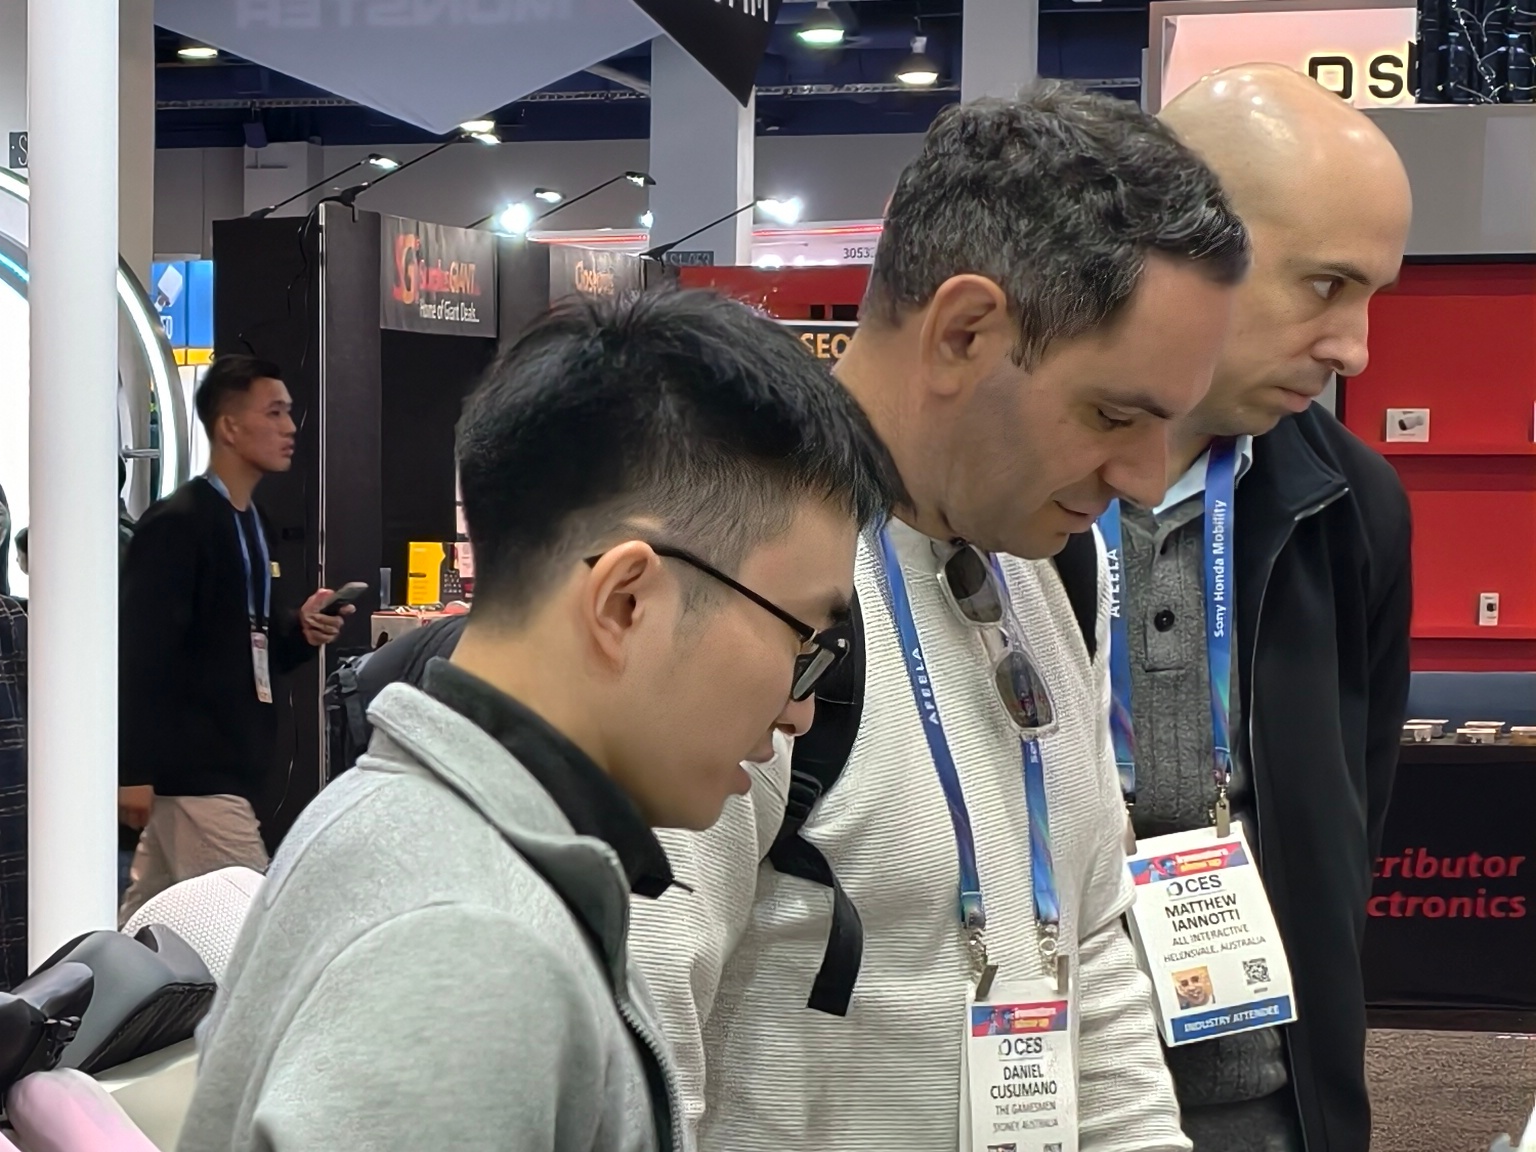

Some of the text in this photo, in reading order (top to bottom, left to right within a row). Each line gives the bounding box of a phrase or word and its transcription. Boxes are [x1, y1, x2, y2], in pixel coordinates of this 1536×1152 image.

[1212, 499, 1228, 638] Sony Honda Mobility
[1185, 874, 1223, 893] CES
[1164, 893, 1238, 919] MATTHEW
[1172, 908, 1241, 933] IANNOTTI
[1172, 923, 1251, 947] ALL INTERACTIVE
[1220, 936, 1267, 952] AUSTRALIA
[1014, 1036, 1043, 1056] CES
[1003, 1064, 1045, 1081] DANIEL
[990, 1080, 1058, 1100] CUSUMANO
